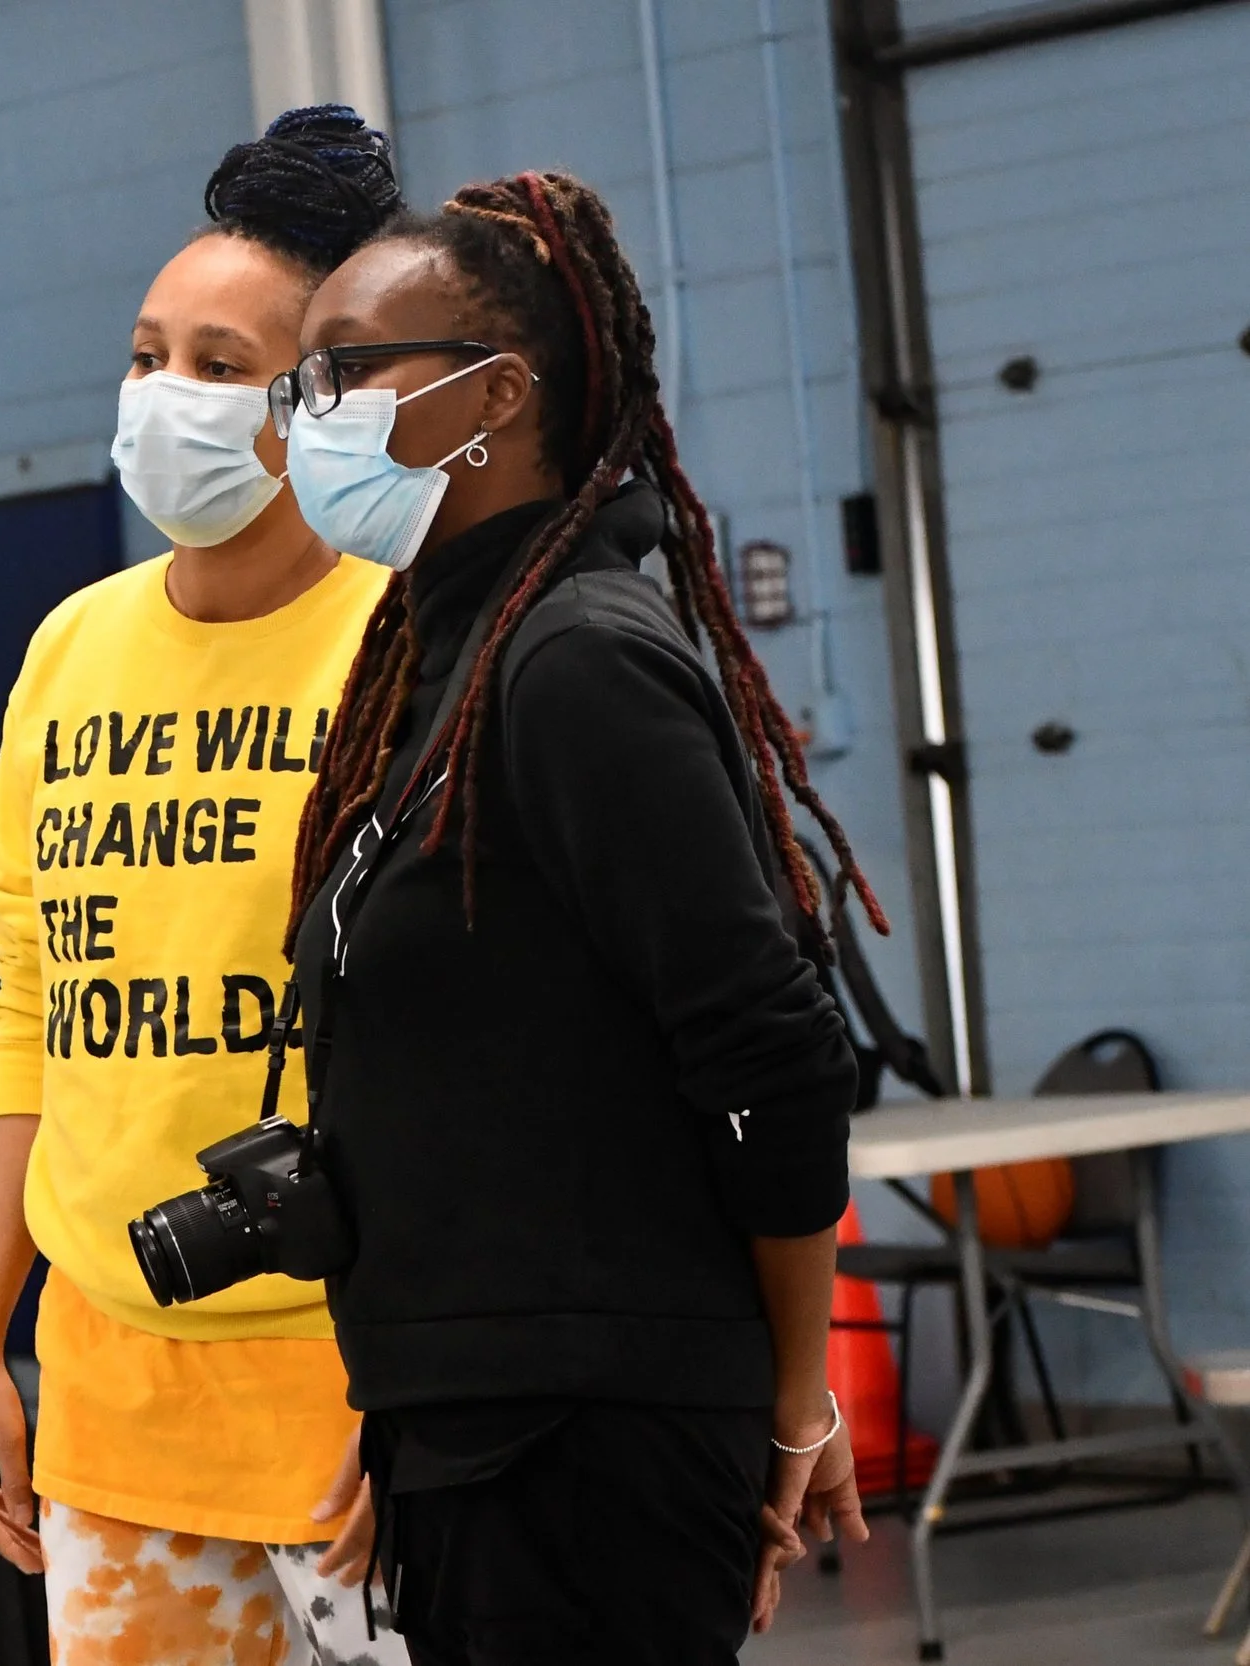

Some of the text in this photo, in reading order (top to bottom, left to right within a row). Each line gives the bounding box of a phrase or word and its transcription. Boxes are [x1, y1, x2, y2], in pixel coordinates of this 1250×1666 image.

[44, 706, 329, 784] LOVE WILL
[36, 798, 261, 871] CHANGE
[40, 895, 118, 963] THE
[267, 1192, 279, 1200] EOS
